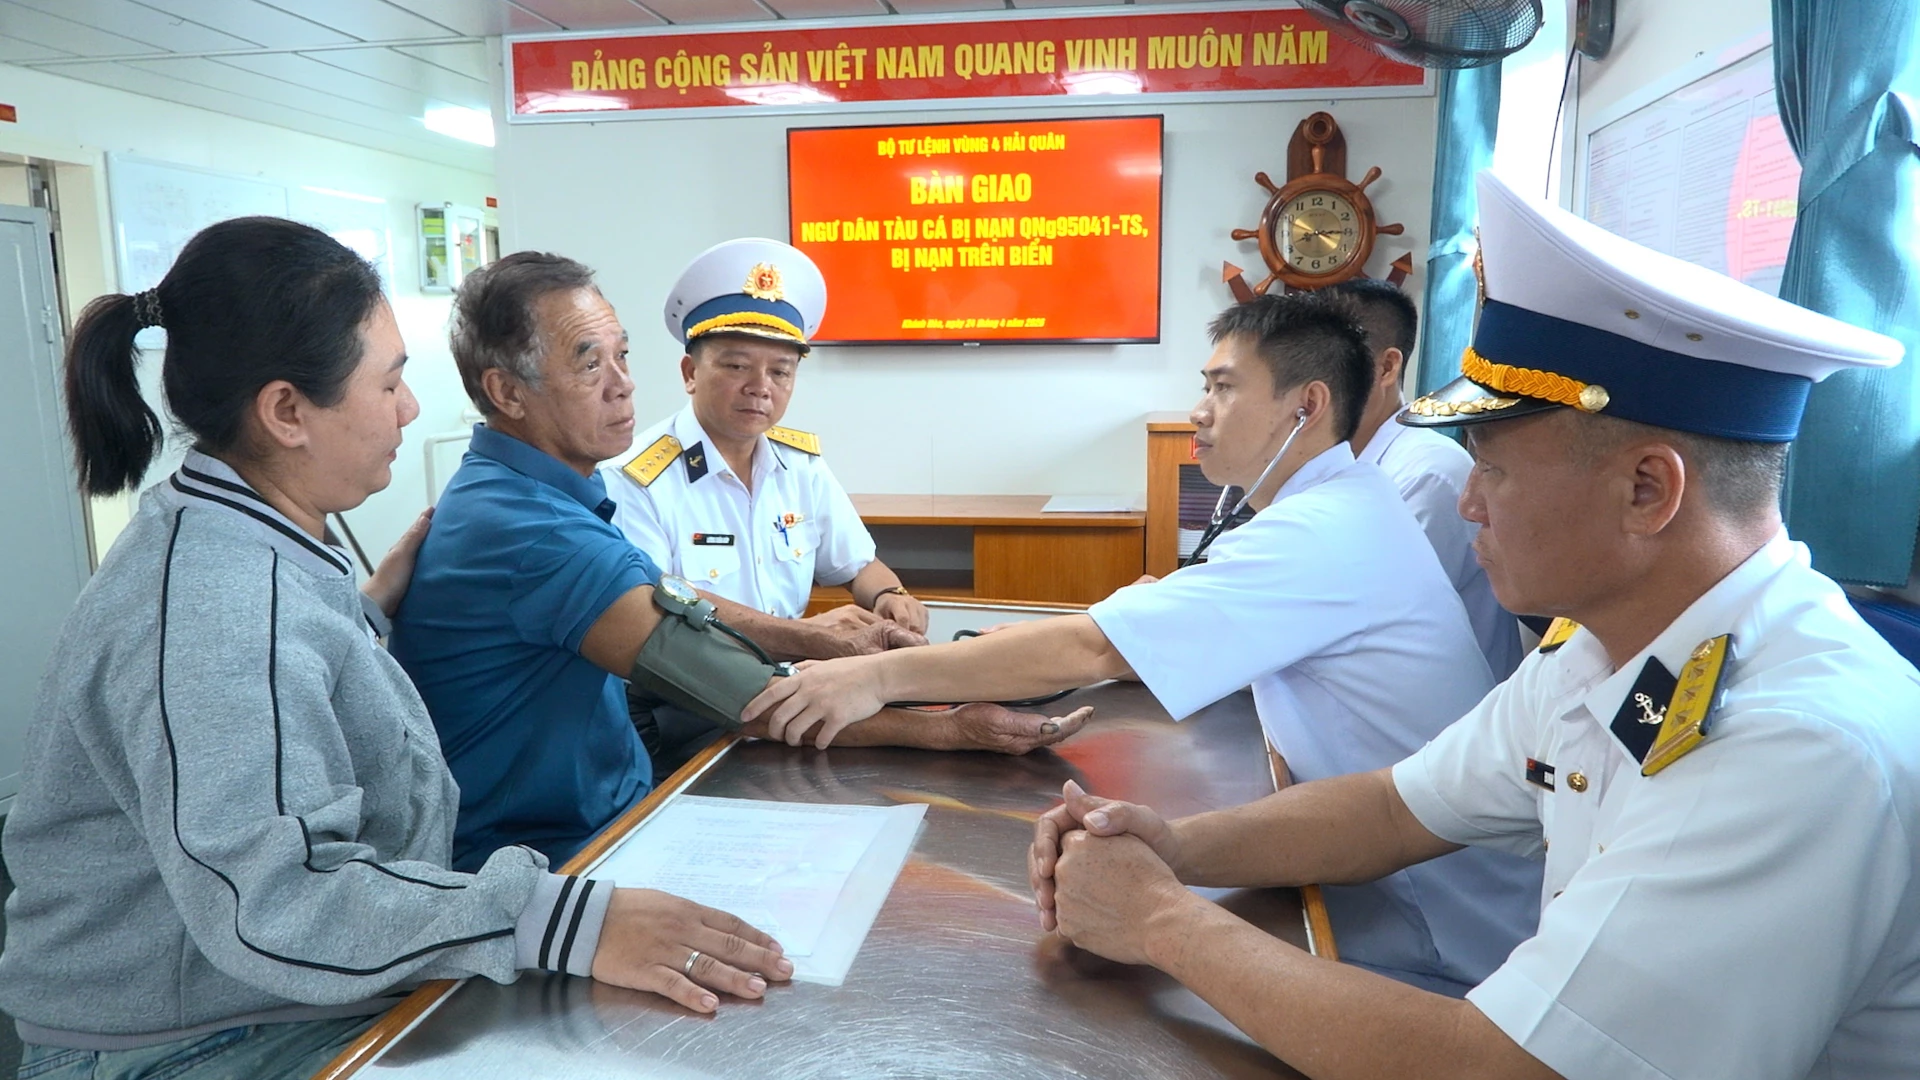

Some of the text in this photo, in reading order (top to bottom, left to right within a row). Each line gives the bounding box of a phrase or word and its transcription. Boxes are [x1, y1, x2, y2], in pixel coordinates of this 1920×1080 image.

[571, 25, 1327, 94] ĐẢNG CỘNG SẢN VIỆT NAM QUANG VINH MUÔN NĂM
[878, 132, 1065, 158] BỘ TƯ LỆNH VÙNG 4 HẢI QUÂN
[910, 170, 1031, 204] BÀN GIAO
[1312, 197, 1323, 205] 12
[1332, 201, 1336, 209] 1
[1296, 202, 1303, 210] 11
[1341, 212, 1350, 221] 2
[802, 214, 1148, 242] NGƯ DÂN TÀU CÁ BỊ NẠN QNg95041-TS,
[892, 236, 1054, 272] BỊ NẠN TRÊN BIỂN
[1295, 257, 1303, 265] 7
[1311, 260, 1320, 269] 6
[1329, 256, 1337, 264] 5
